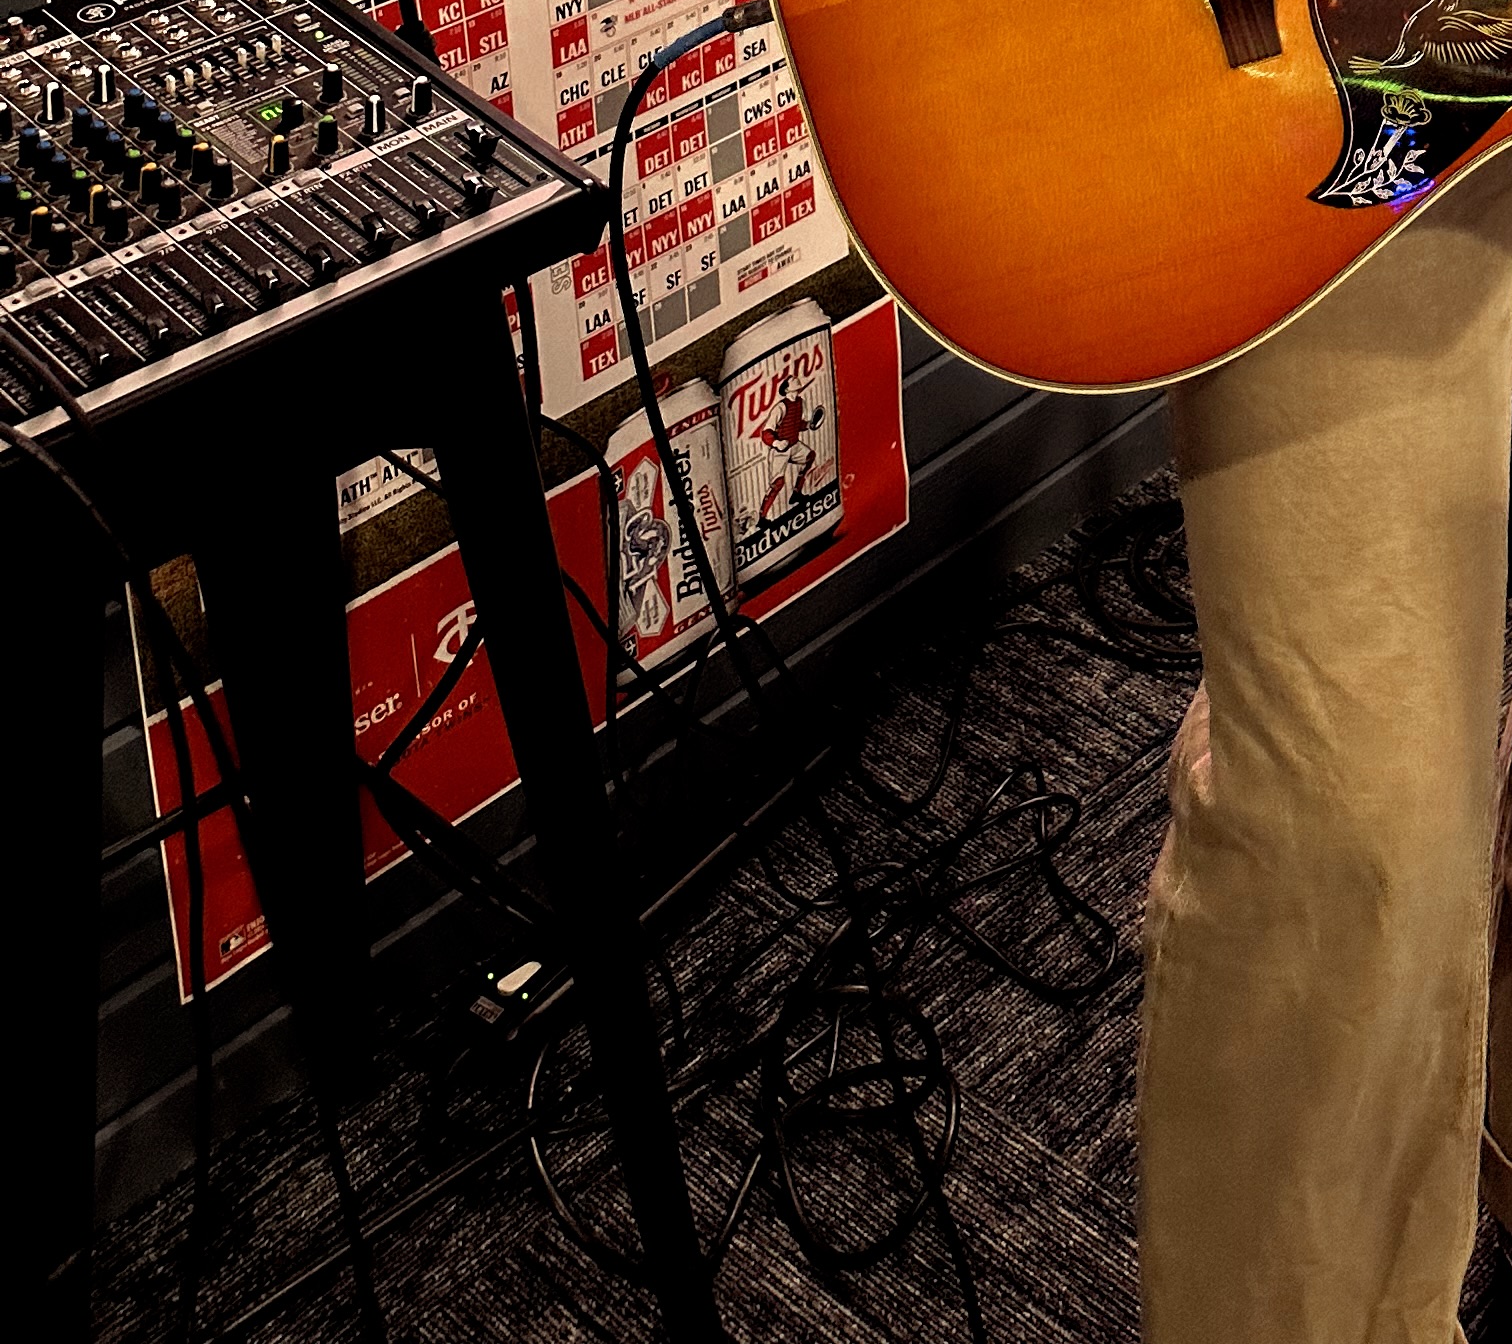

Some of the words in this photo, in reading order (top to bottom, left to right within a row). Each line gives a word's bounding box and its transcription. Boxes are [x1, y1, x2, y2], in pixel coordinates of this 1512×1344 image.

[439, 48, 468, 72] STL
[559, 40, 588, 65] LAA
[624, 11, 642, 25] MLB
[489, 71, 510, 95] AZ
[560, 79, 591, 107] CHC
[743, 38, 767, 61] SEA
[376, 133, 412, 154] MON
[422, 113, 459, 134] MAIN
[666, 272, 683, 290] SF
[758, 214, 783, 240] TEX
[735, 487, 839, 571] Budweiser
